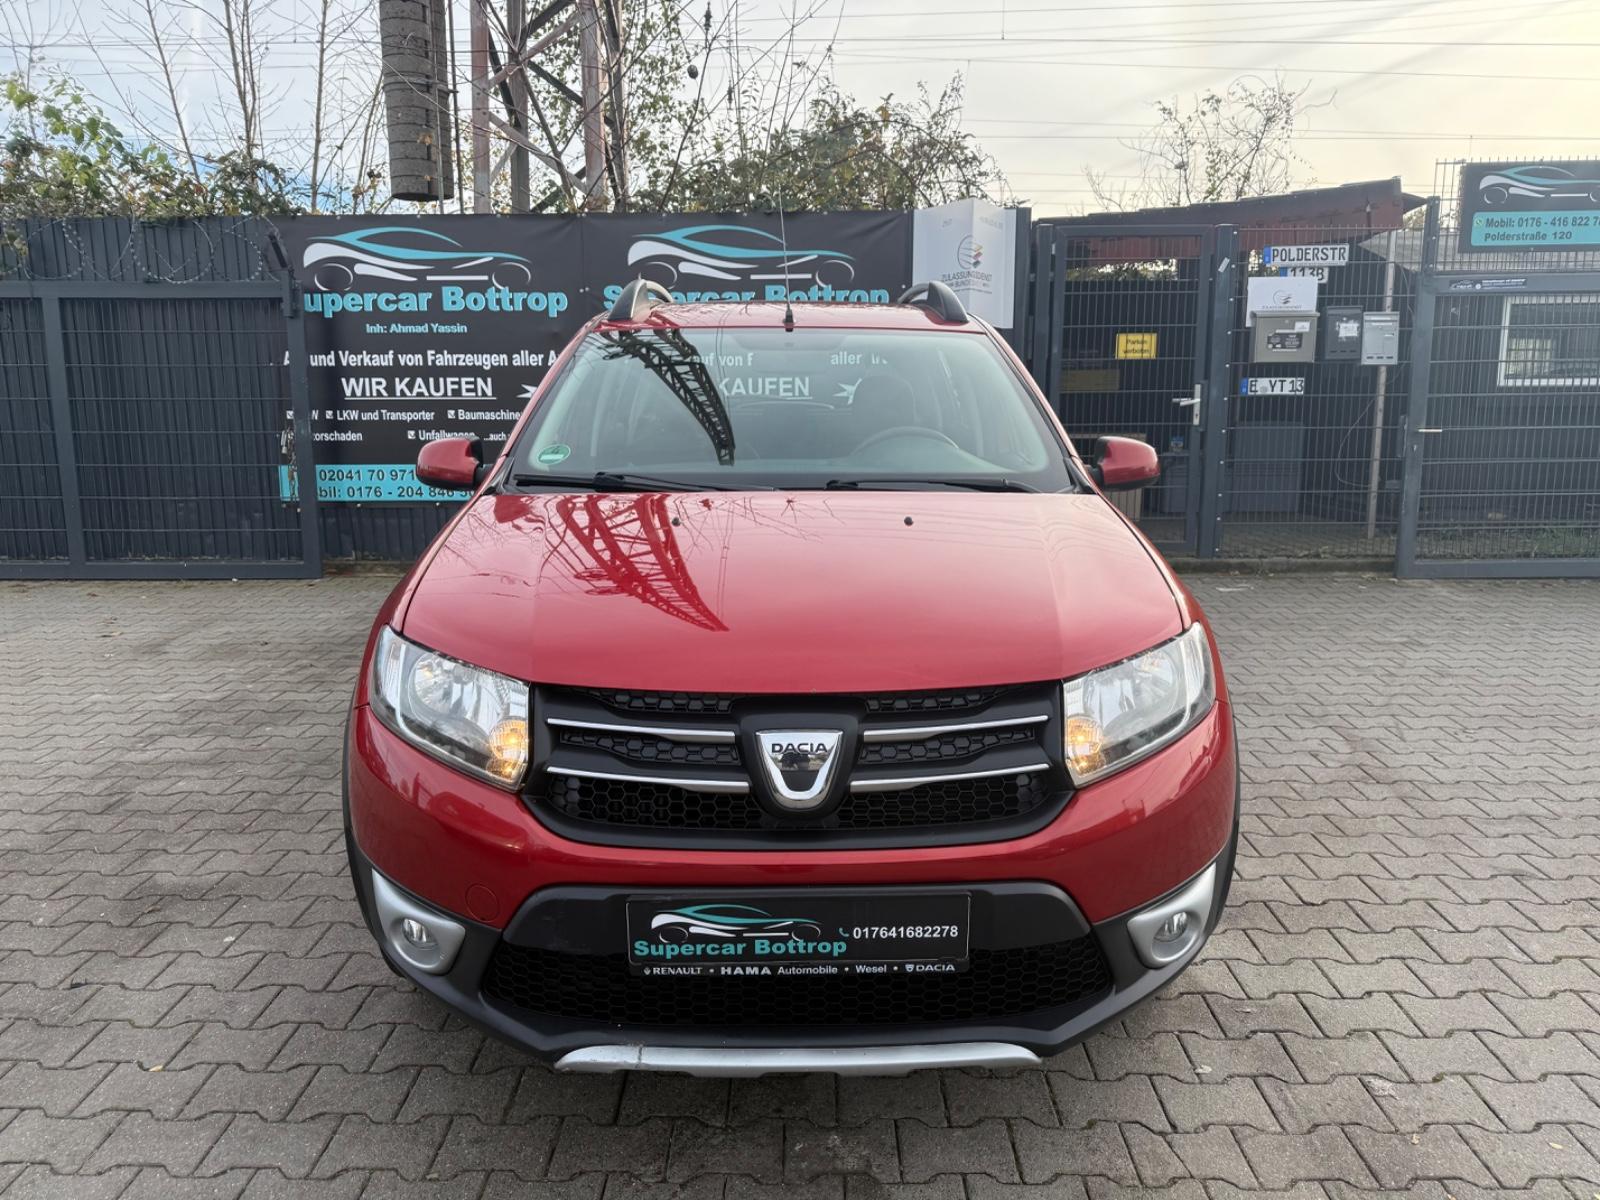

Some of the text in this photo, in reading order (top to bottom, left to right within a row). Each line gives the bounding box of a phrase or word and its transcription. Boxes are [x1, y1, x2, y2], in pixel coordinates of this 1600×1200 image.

[1485, 217, 1515, 228] Mobil:
[1517, 217, 1542, 228] 0176
[1550, 216, 1568, 227] 416
[1484, 231, 1573, 242] Polderstraße 120
[1271, 246, 1347, 262] POLDERSTR
[303, 285, 569, 318] upercar Bottrop
[366, 323, 468, 334] Inh: Ahmad Yassin
[309, 350, 336, 367] und
[338, 350, 395, 367] Verkauf
[397, 353, 423, 367] von
[426, 350, 509, 371] Fahrzeugen
[512, 350, 544, 367] aller
[718, 354, 743, 367] von
[830, 352, 862, 365] aller
[341, 377, 493, 397] WIR KAUFEN
[336, 409, 436, 423] LKW und Transporter
[457, 409, 524, 421] Baumaschine
[313, 430, 363, 442] orschaden
[318, 468, 363, 482] 02041
[367, 469, 385, 482] 70
[346, 486, 383, 498] 0176
[396, 486, 424, 498] 204
[771, 742, 828, 753] DACIA
[852, 925, 959, 940] 017641682278
[633, 938, 847, 960] Supercar Bottrop
[652, 963, 956, 976] RENAULT HAMA Automobile Wesel DACIA
